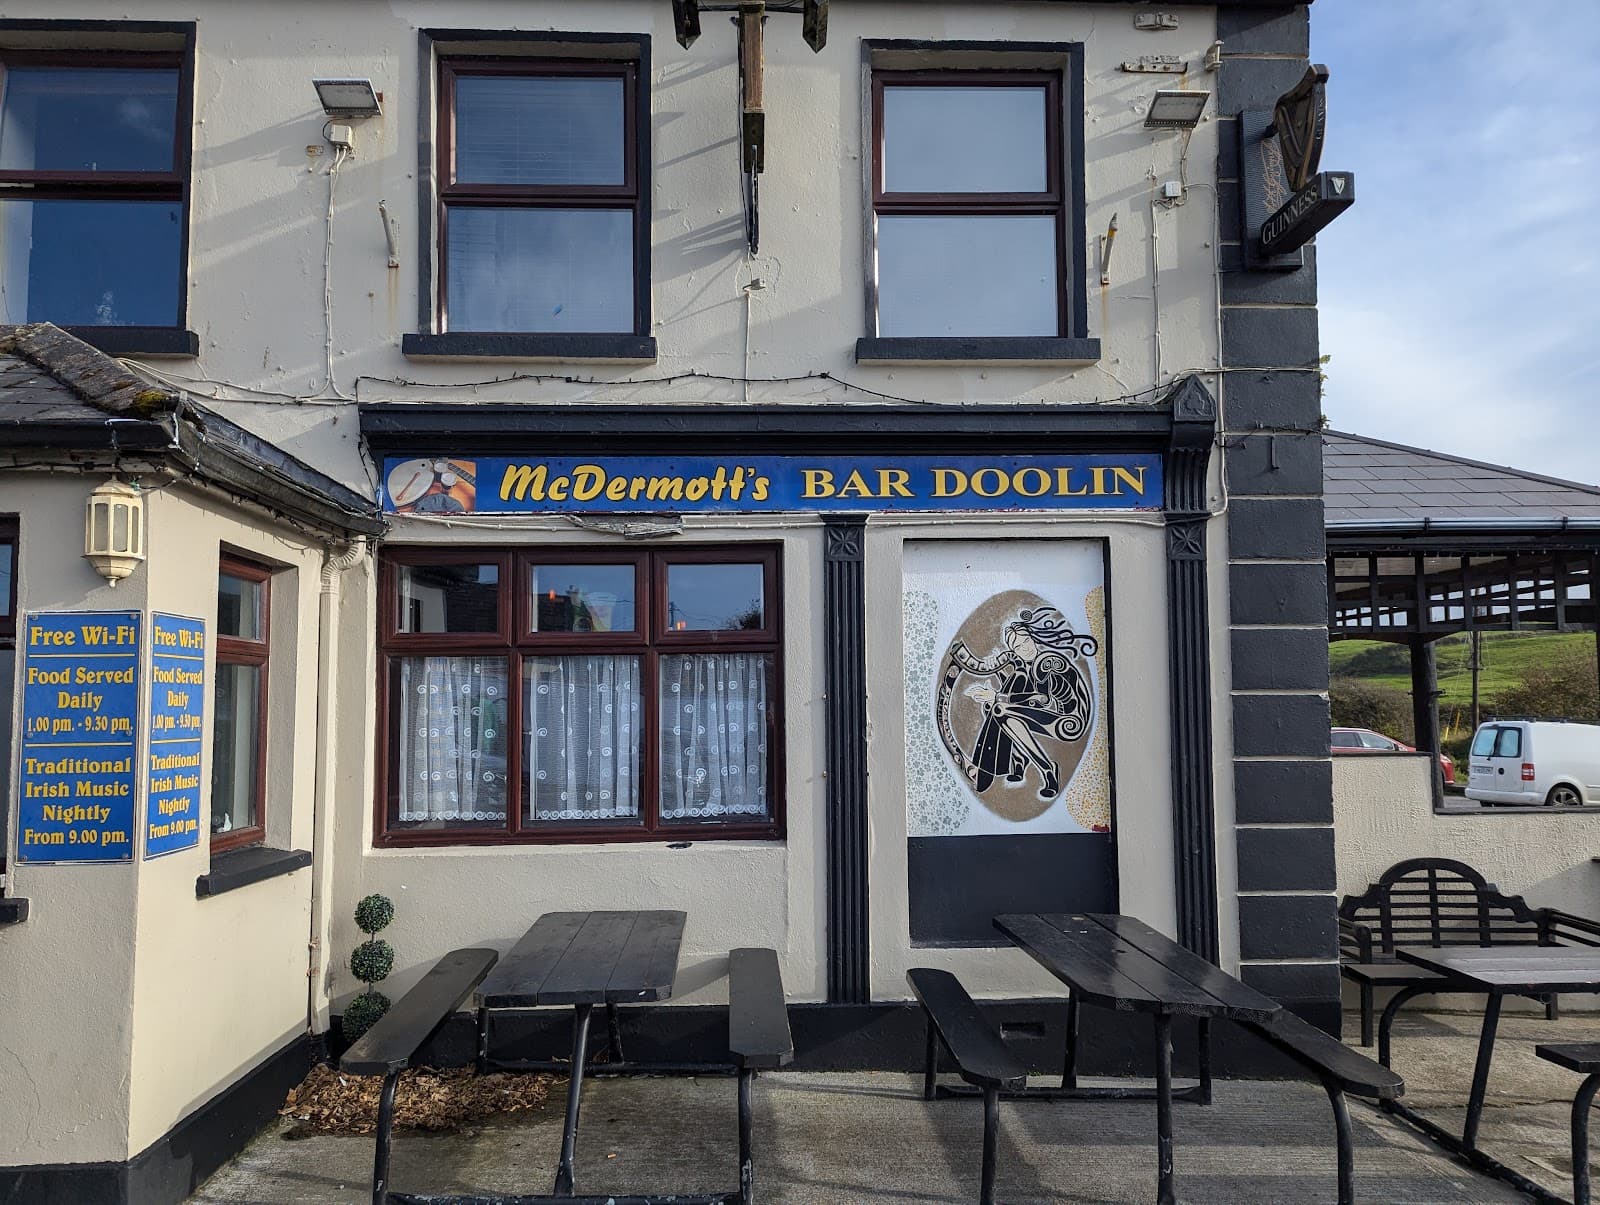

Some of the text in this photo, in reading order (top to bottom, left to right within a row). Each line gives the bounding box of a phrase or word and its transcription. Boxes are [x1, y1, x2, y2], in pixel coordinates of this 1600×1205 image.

[1262, 185, 1318, 245] GUINNESS
[500, 464, 1147, 501] McDermott's BAR DOOLIN
[30, 625, 136, 646] Free Wi-Fi
[153, 626, 204, 650] Free Wi-Fi
[27, 666, 134, 685] Food Served
[152, 665, 203, 685] Food Served
[57, 691, 103, 712] Daily
[167, 690, 190, 710] Daily
[27, 716, 50, 732] 1.00
[52, 718, 75, 736] pm.
[85, 715, 108, 732] 9.30
[110, 717, 134, 735] pm.
[24, 757, 132, 775] Traditional
[150, 751, 201, 771] Traditional
[25, 780, 130, 798] Irish Music
[150, 773, 199, 794] Irish Music
[42, 804, 111, 825] Nightly
[158, 795, 191, 817] Nightly
[24, 828, 130, 847] From 9.00 pm.
[149, 818, 199, 840] From 9.00 pm.
